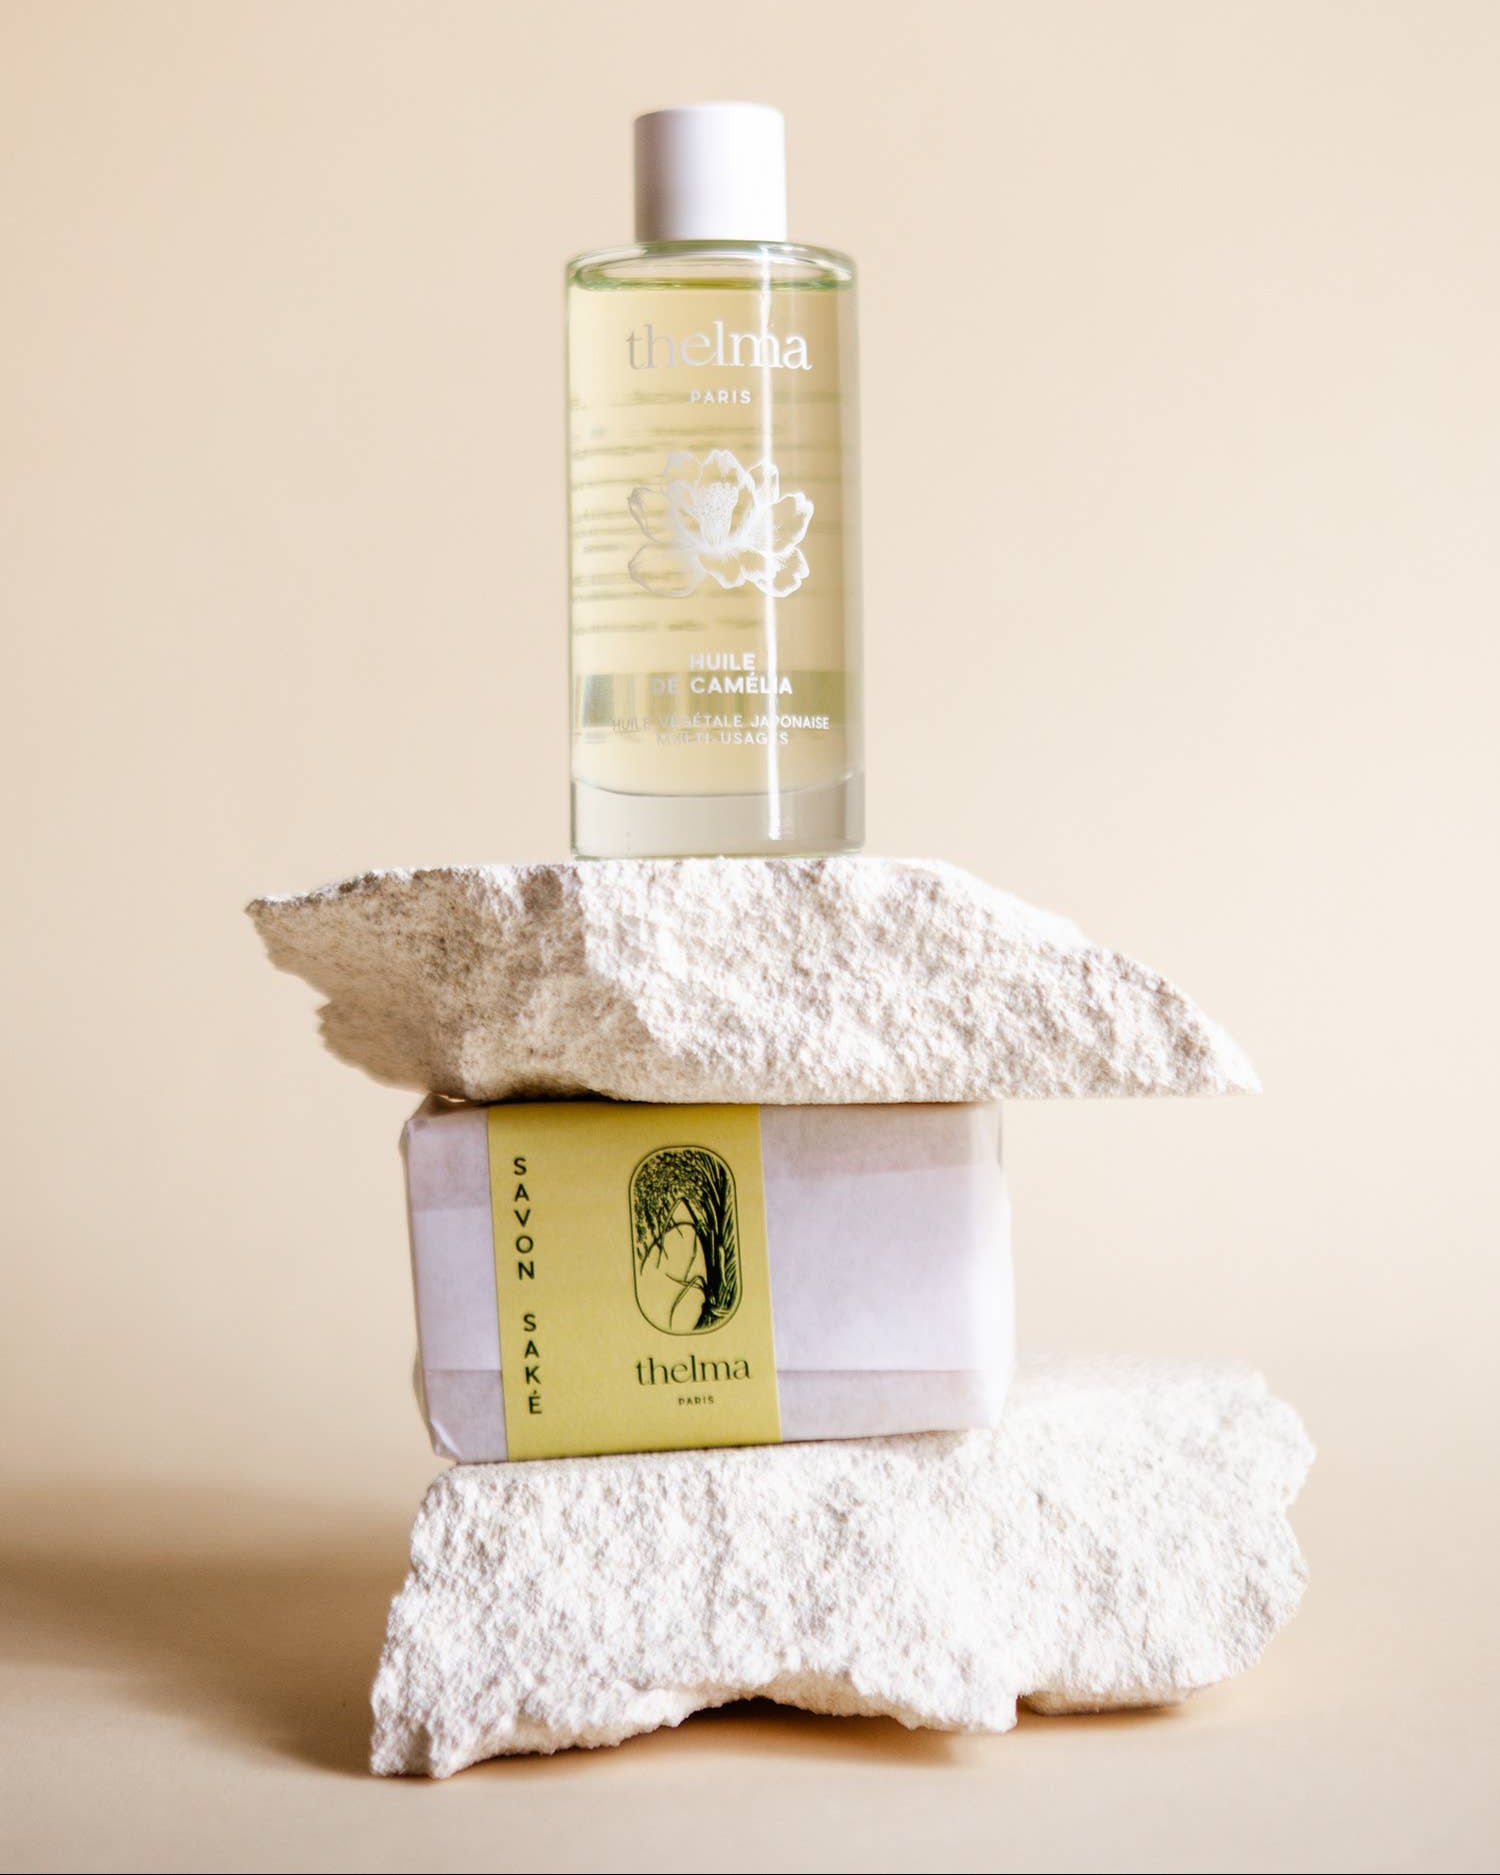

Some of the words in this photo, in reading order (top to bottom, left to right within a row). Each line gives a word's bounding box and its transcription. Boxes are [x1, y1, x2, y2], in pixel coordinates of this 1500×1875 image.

[625, 319, 813, 371] thelma
[690, 390, 752, 404] PARIS
[689, 653, 755, 671] HUILE
[652, 676, 680, 695] DE
[690, 671, 793, 695] CAMÉLIA
[513, 1157, 535, 1280] SAVON
[523, 1313, 542, 1414] SAKÉ
[636, 1354, 751, 1386] thelma
[678, 1395, 715, 1406] PARIS
